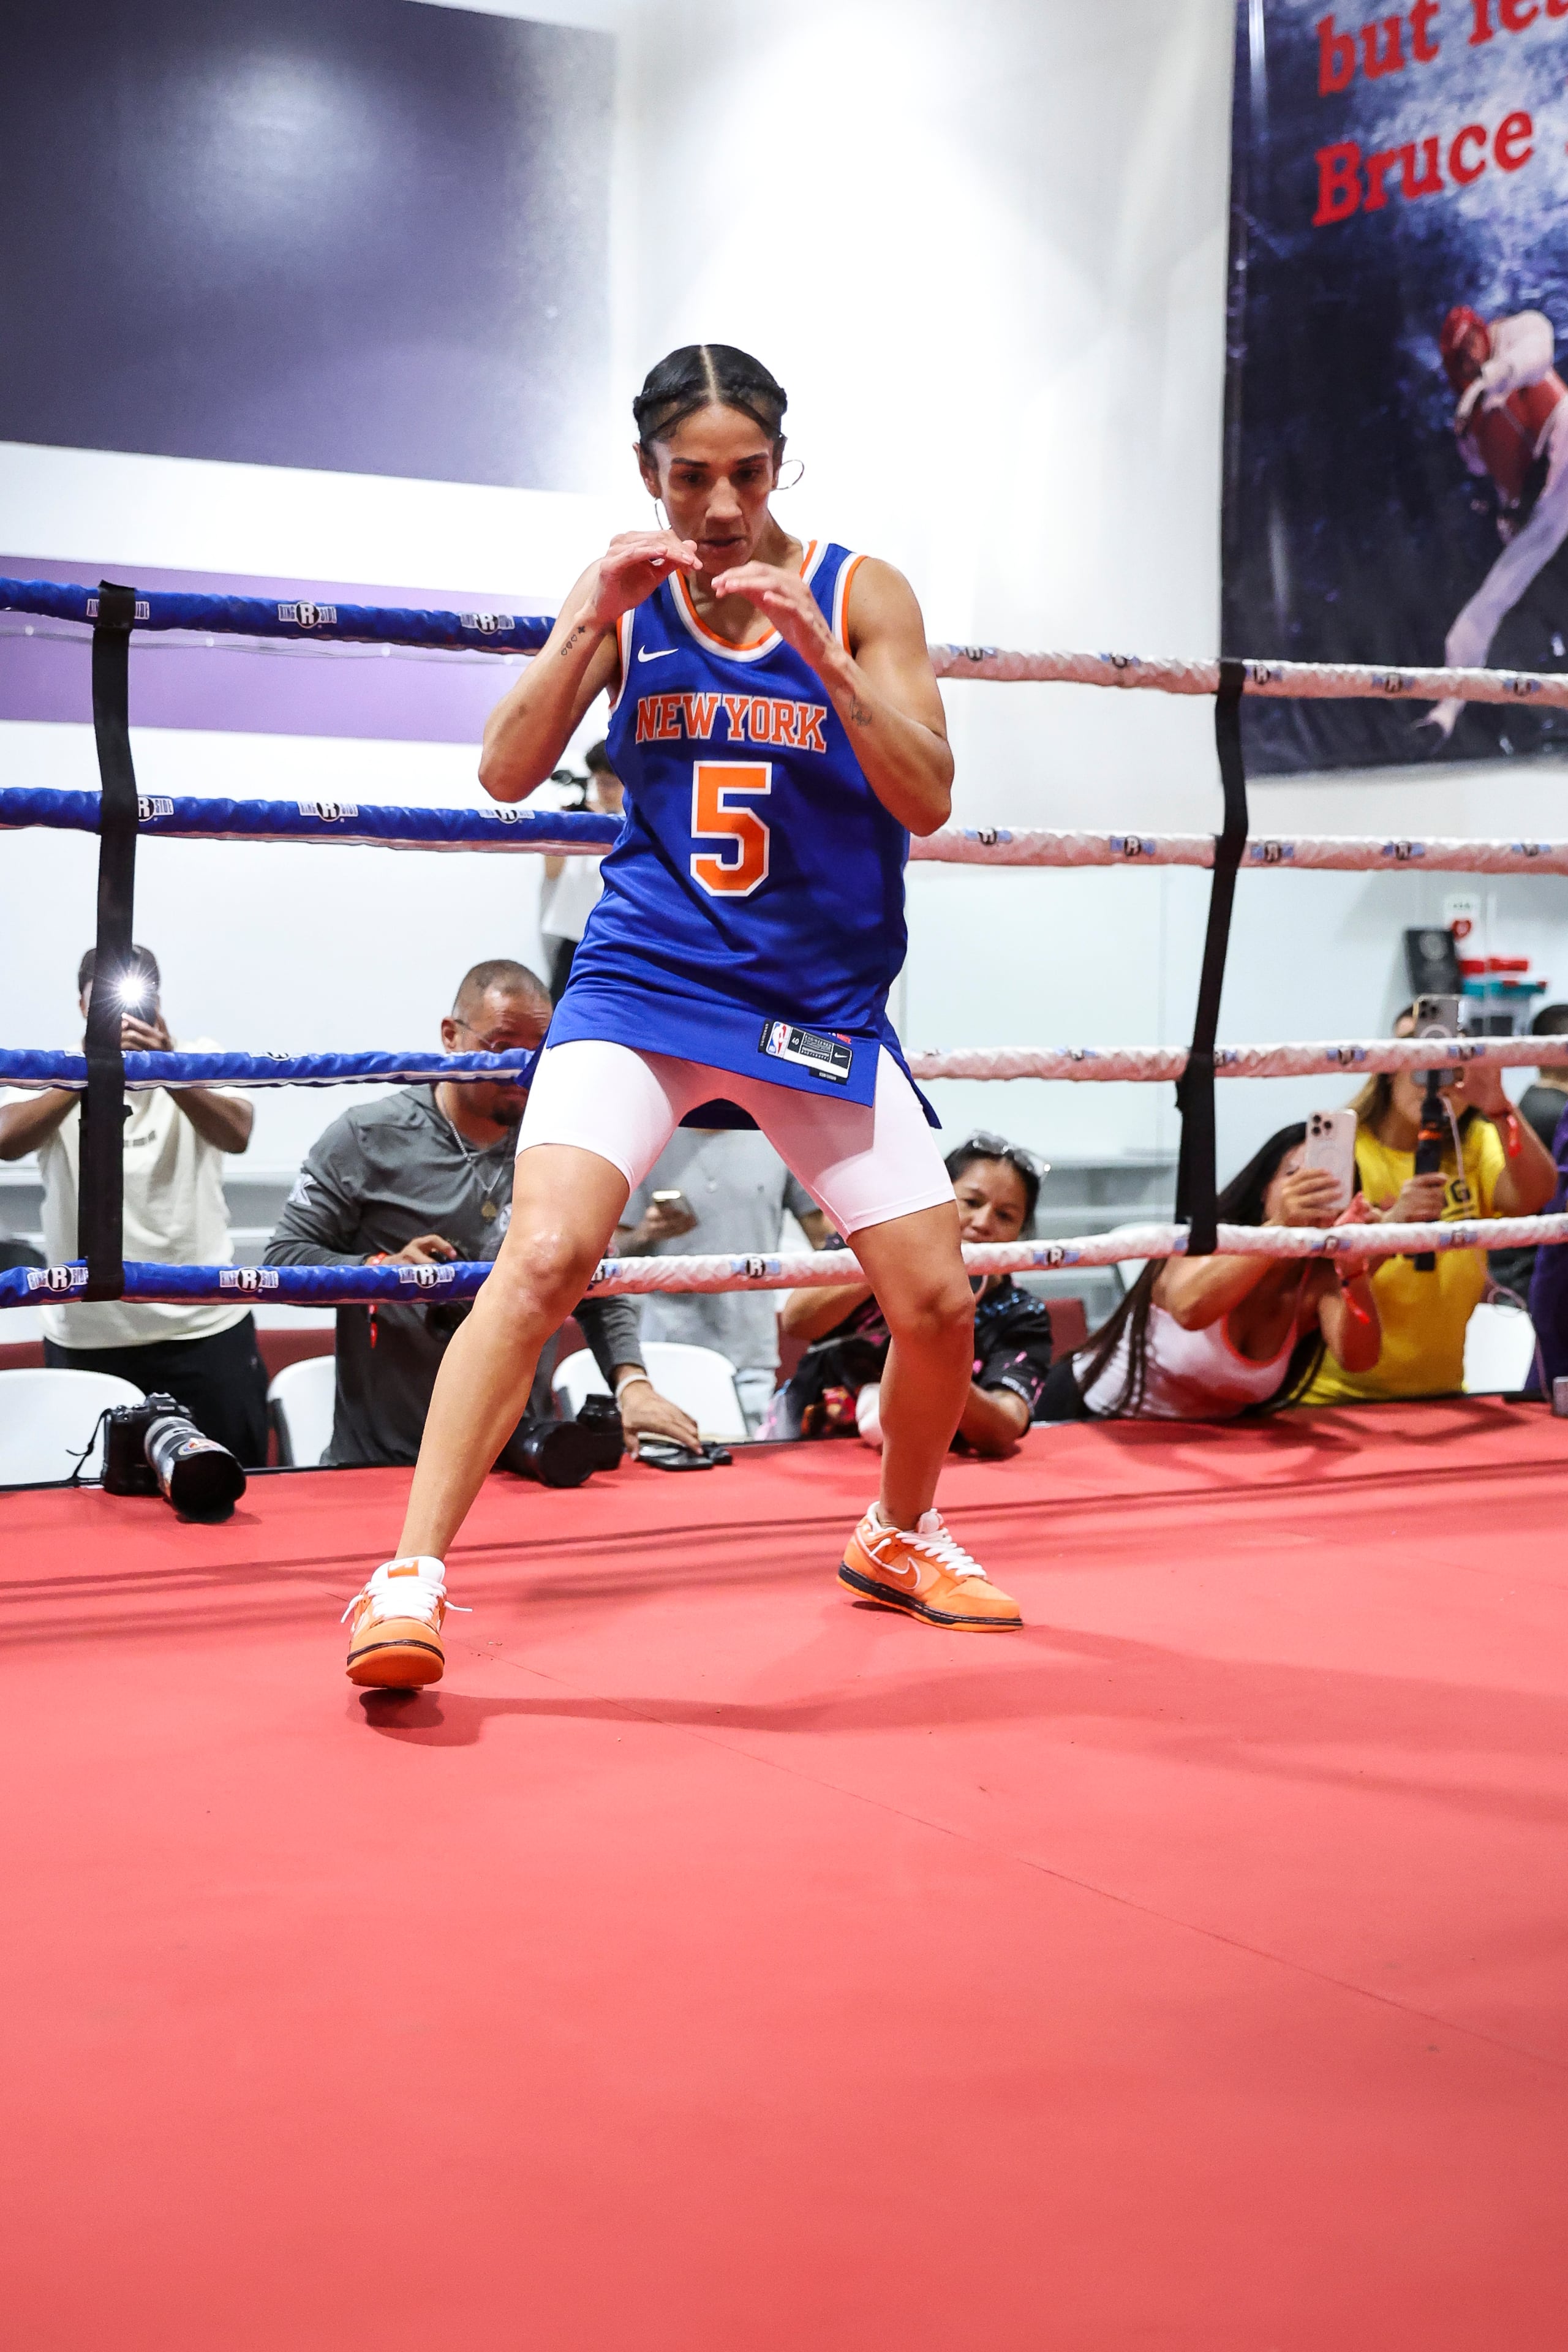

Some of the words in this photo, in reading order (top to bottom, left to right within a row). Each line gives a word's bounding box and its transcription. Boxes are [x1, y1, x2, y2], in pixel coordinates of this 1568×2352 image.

[1316, 0, 1439, 97] but
[1311, 111, 1534, 227] Bruce
[635, 692, 722, 745] NEW
[722, 693, 827, 754] YORK
[690, 760, 772, 897] 5
[51, 1267, 68, 1289] R
[242, 1270, 257, 1289] R
